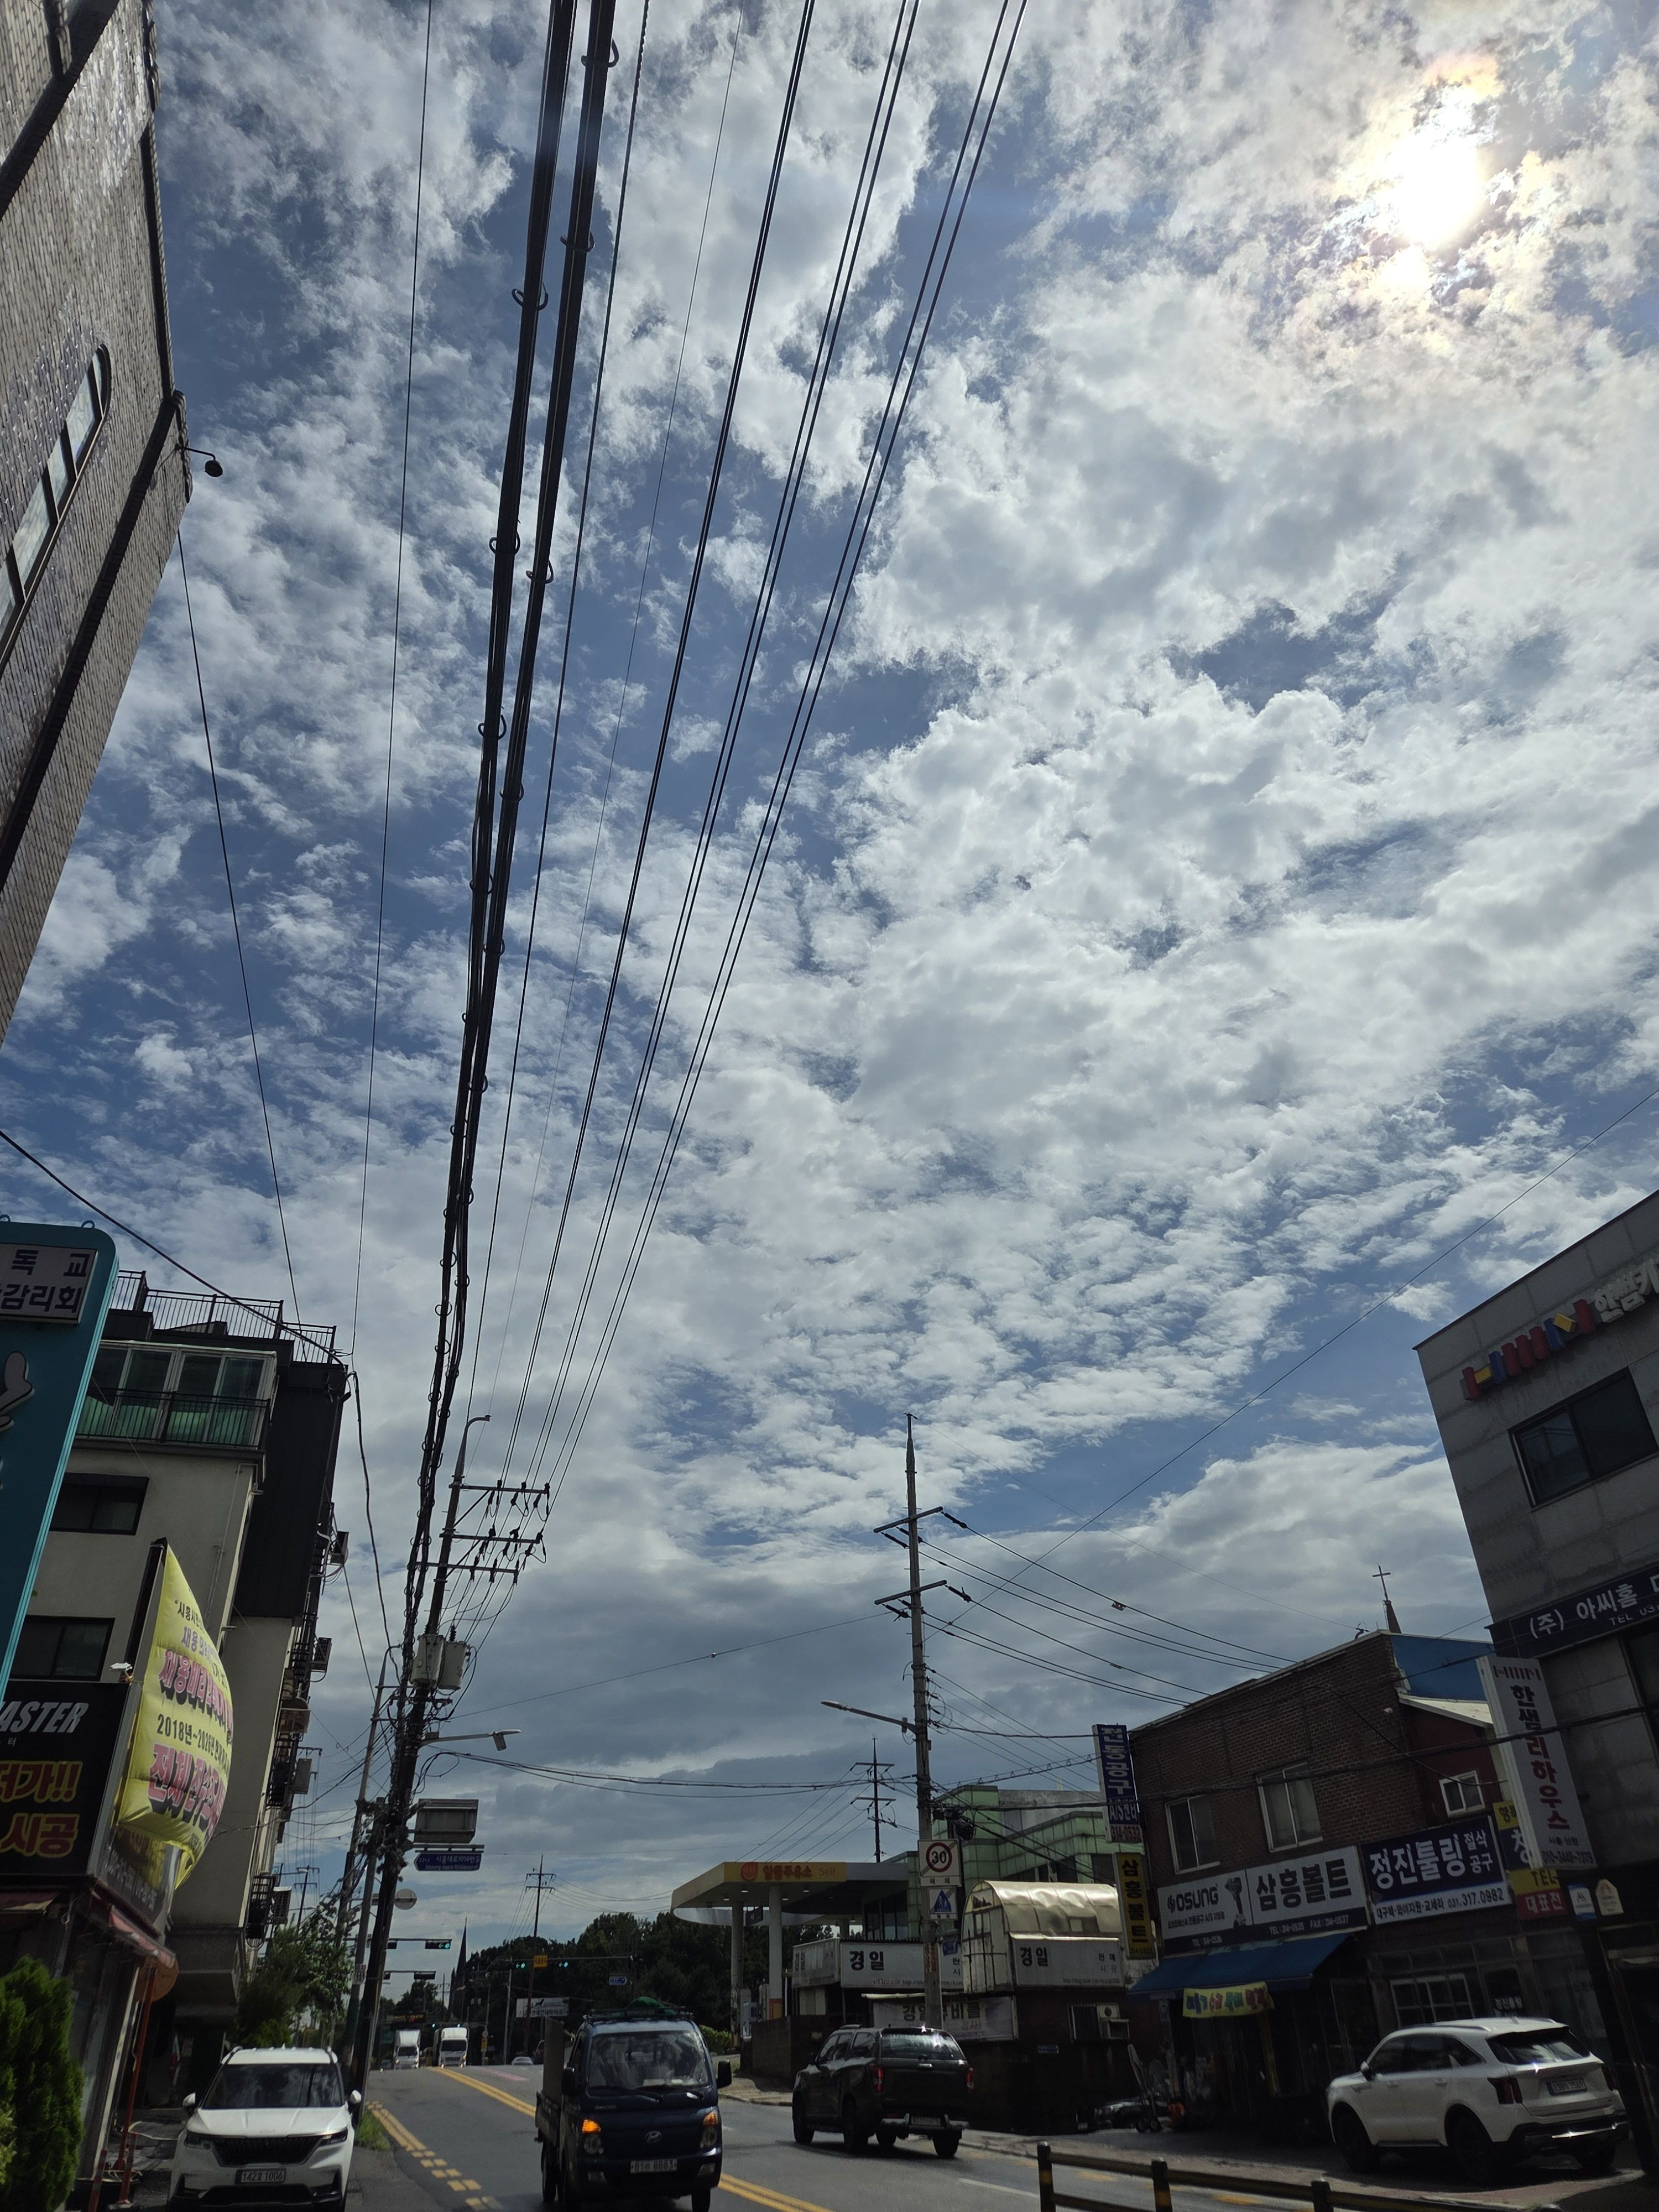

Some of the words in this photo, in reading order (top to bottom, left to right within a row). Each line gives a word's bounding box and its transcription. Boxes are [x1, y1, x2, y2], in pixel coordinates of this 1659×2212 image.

[0, 1284, 82, 1313] 감리회
[1530, 1609, 1564, 1639] (주)
[1577, 1583, 1637, 1620] 아씨홈
[1609, 1613, 1634, 1626] TEL
[0, 1700, 89, 1733] ASTER
[1100, 1727, 1132, 1795] 전동공구
[0, 1812, 80, 1858] 시공
[1112, 1826, 1141, 1840] 314-0532
[1463, 1829, 1487, 1851] 절삭
[932, 1851, 947, 1864] 30
[1369, 1833, 1466, 1889] 정진툴링
[1469, 1853, 1494, 1874] 공구
[819, 1867, 836, 1877] Self
[1256, 1858, 1352, 1912] 삼흥볼트
[1121, 1860, 1148, 1943] 삼흥볼트
[1525, 1891, 1563, 1914] 대표전
[849, 1950, 884, 1970] 경일
[1020, 1947, 1048, 1966] 경일
[265, 2171, 284, 2182] 1006
